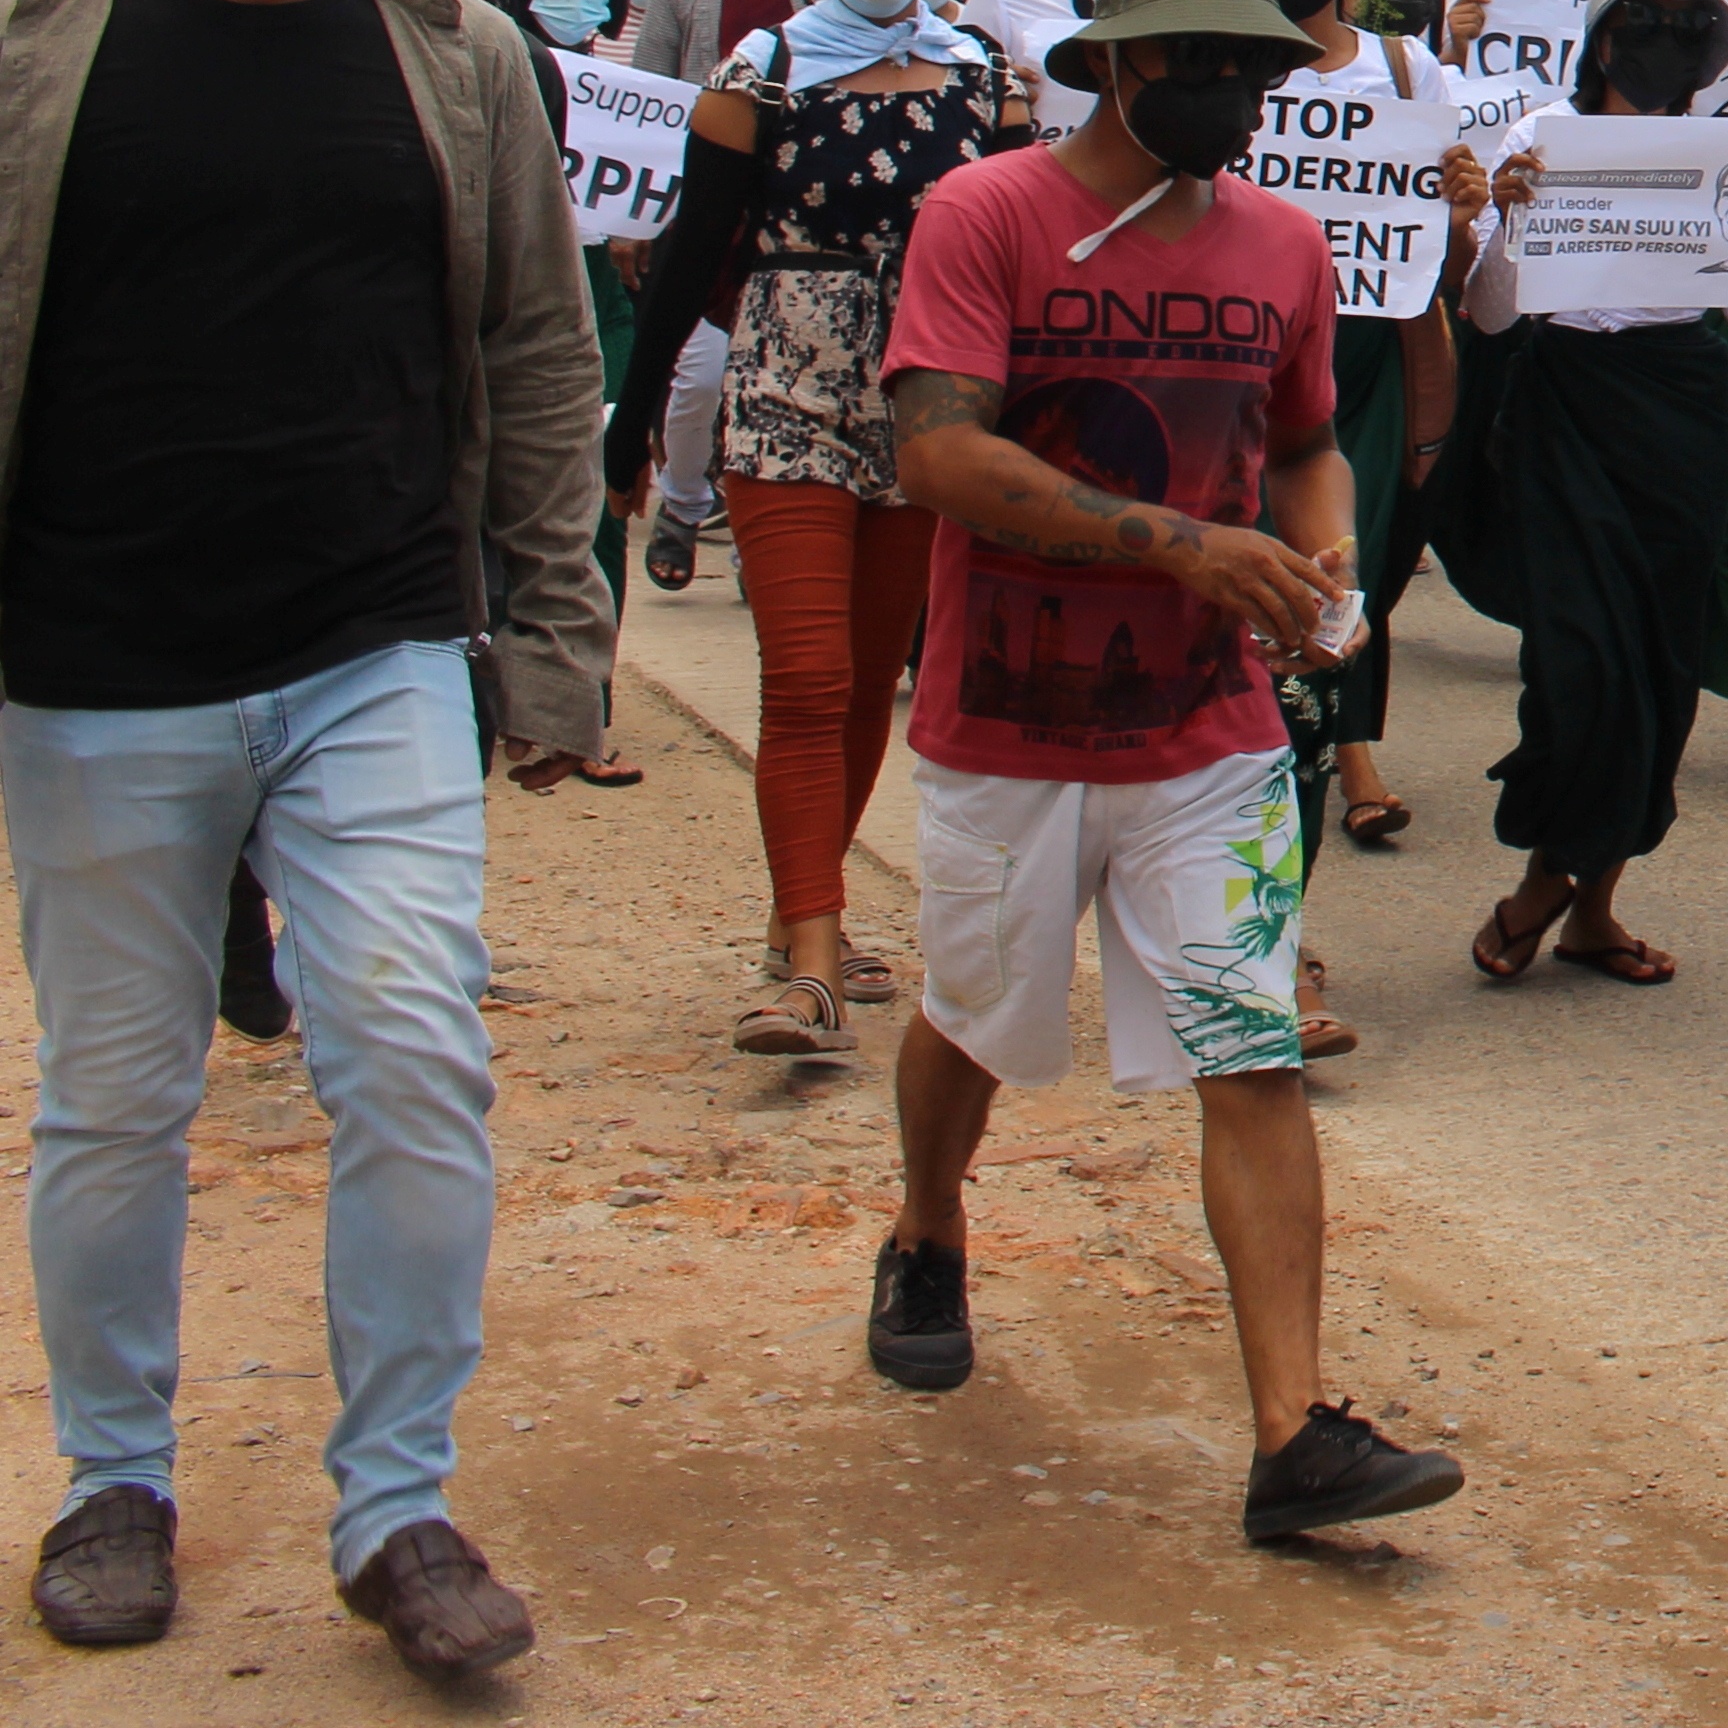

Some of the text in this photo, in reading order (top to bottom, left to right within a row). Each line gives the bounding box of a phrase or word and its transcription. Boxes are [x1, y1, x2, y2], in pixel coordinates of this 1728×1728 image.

[1254, 95, 1375, 142] TOP
[1457, 88, 1531, 140] port
[1600, 173, 1696, 186] Immediately
[1526, 197, 1613, 211] Our Leader
[1525, 218, 1711, 237] AUNG SAN SUU KYI
[1556, 241, 1633, 254] ARRESTED
[1635, 242, 1708, 255] PERSONS
